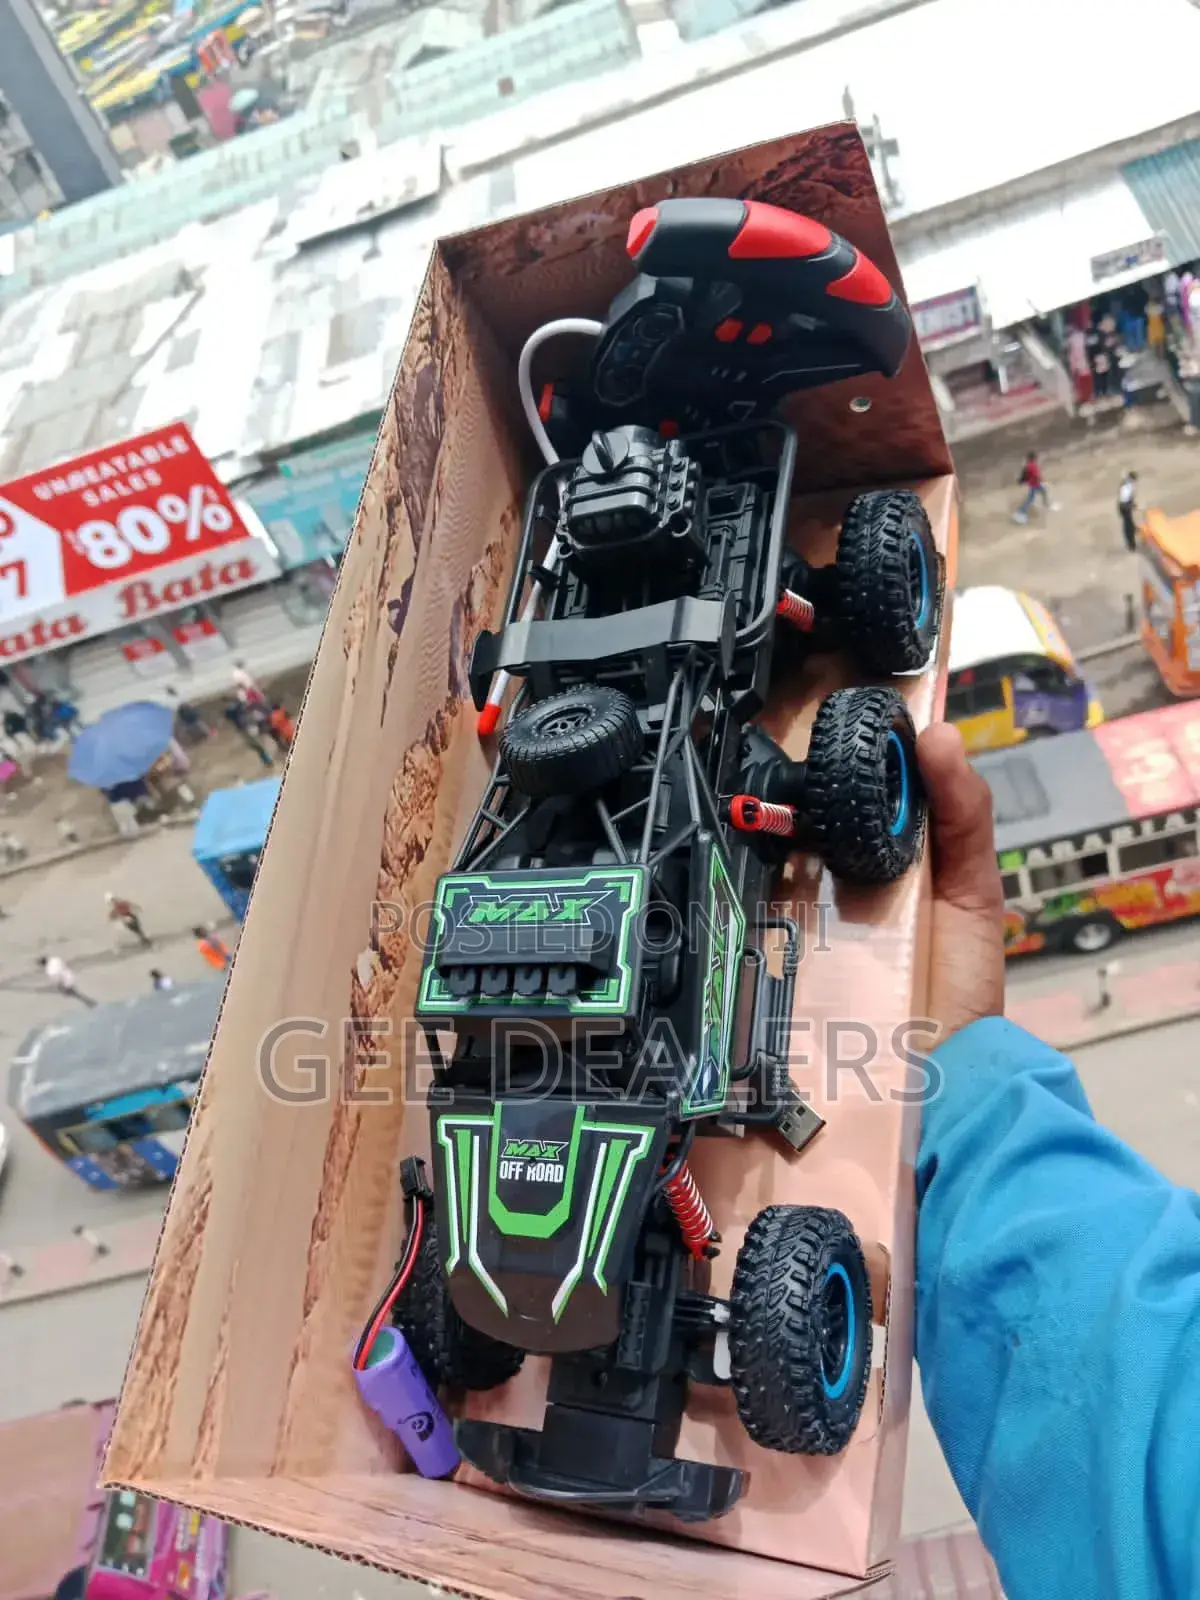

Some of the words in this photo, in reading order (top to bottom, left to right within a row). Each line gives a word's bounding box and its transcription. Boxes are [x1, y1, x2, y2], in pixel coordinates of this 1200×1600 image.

[32, 434, 190, 500] UNBEATABLE
[81, 467, 163, 507] SALES
[75, 484, 234, 569] 80%
[117, 556, 257, 620] Bata
[467, 894, 598, 924] MAX
[504, 1140, 564, 1160] MAX
[499, 1161, 524, 1181] OFF
[526, 1162, 565, 1184] ROAD
